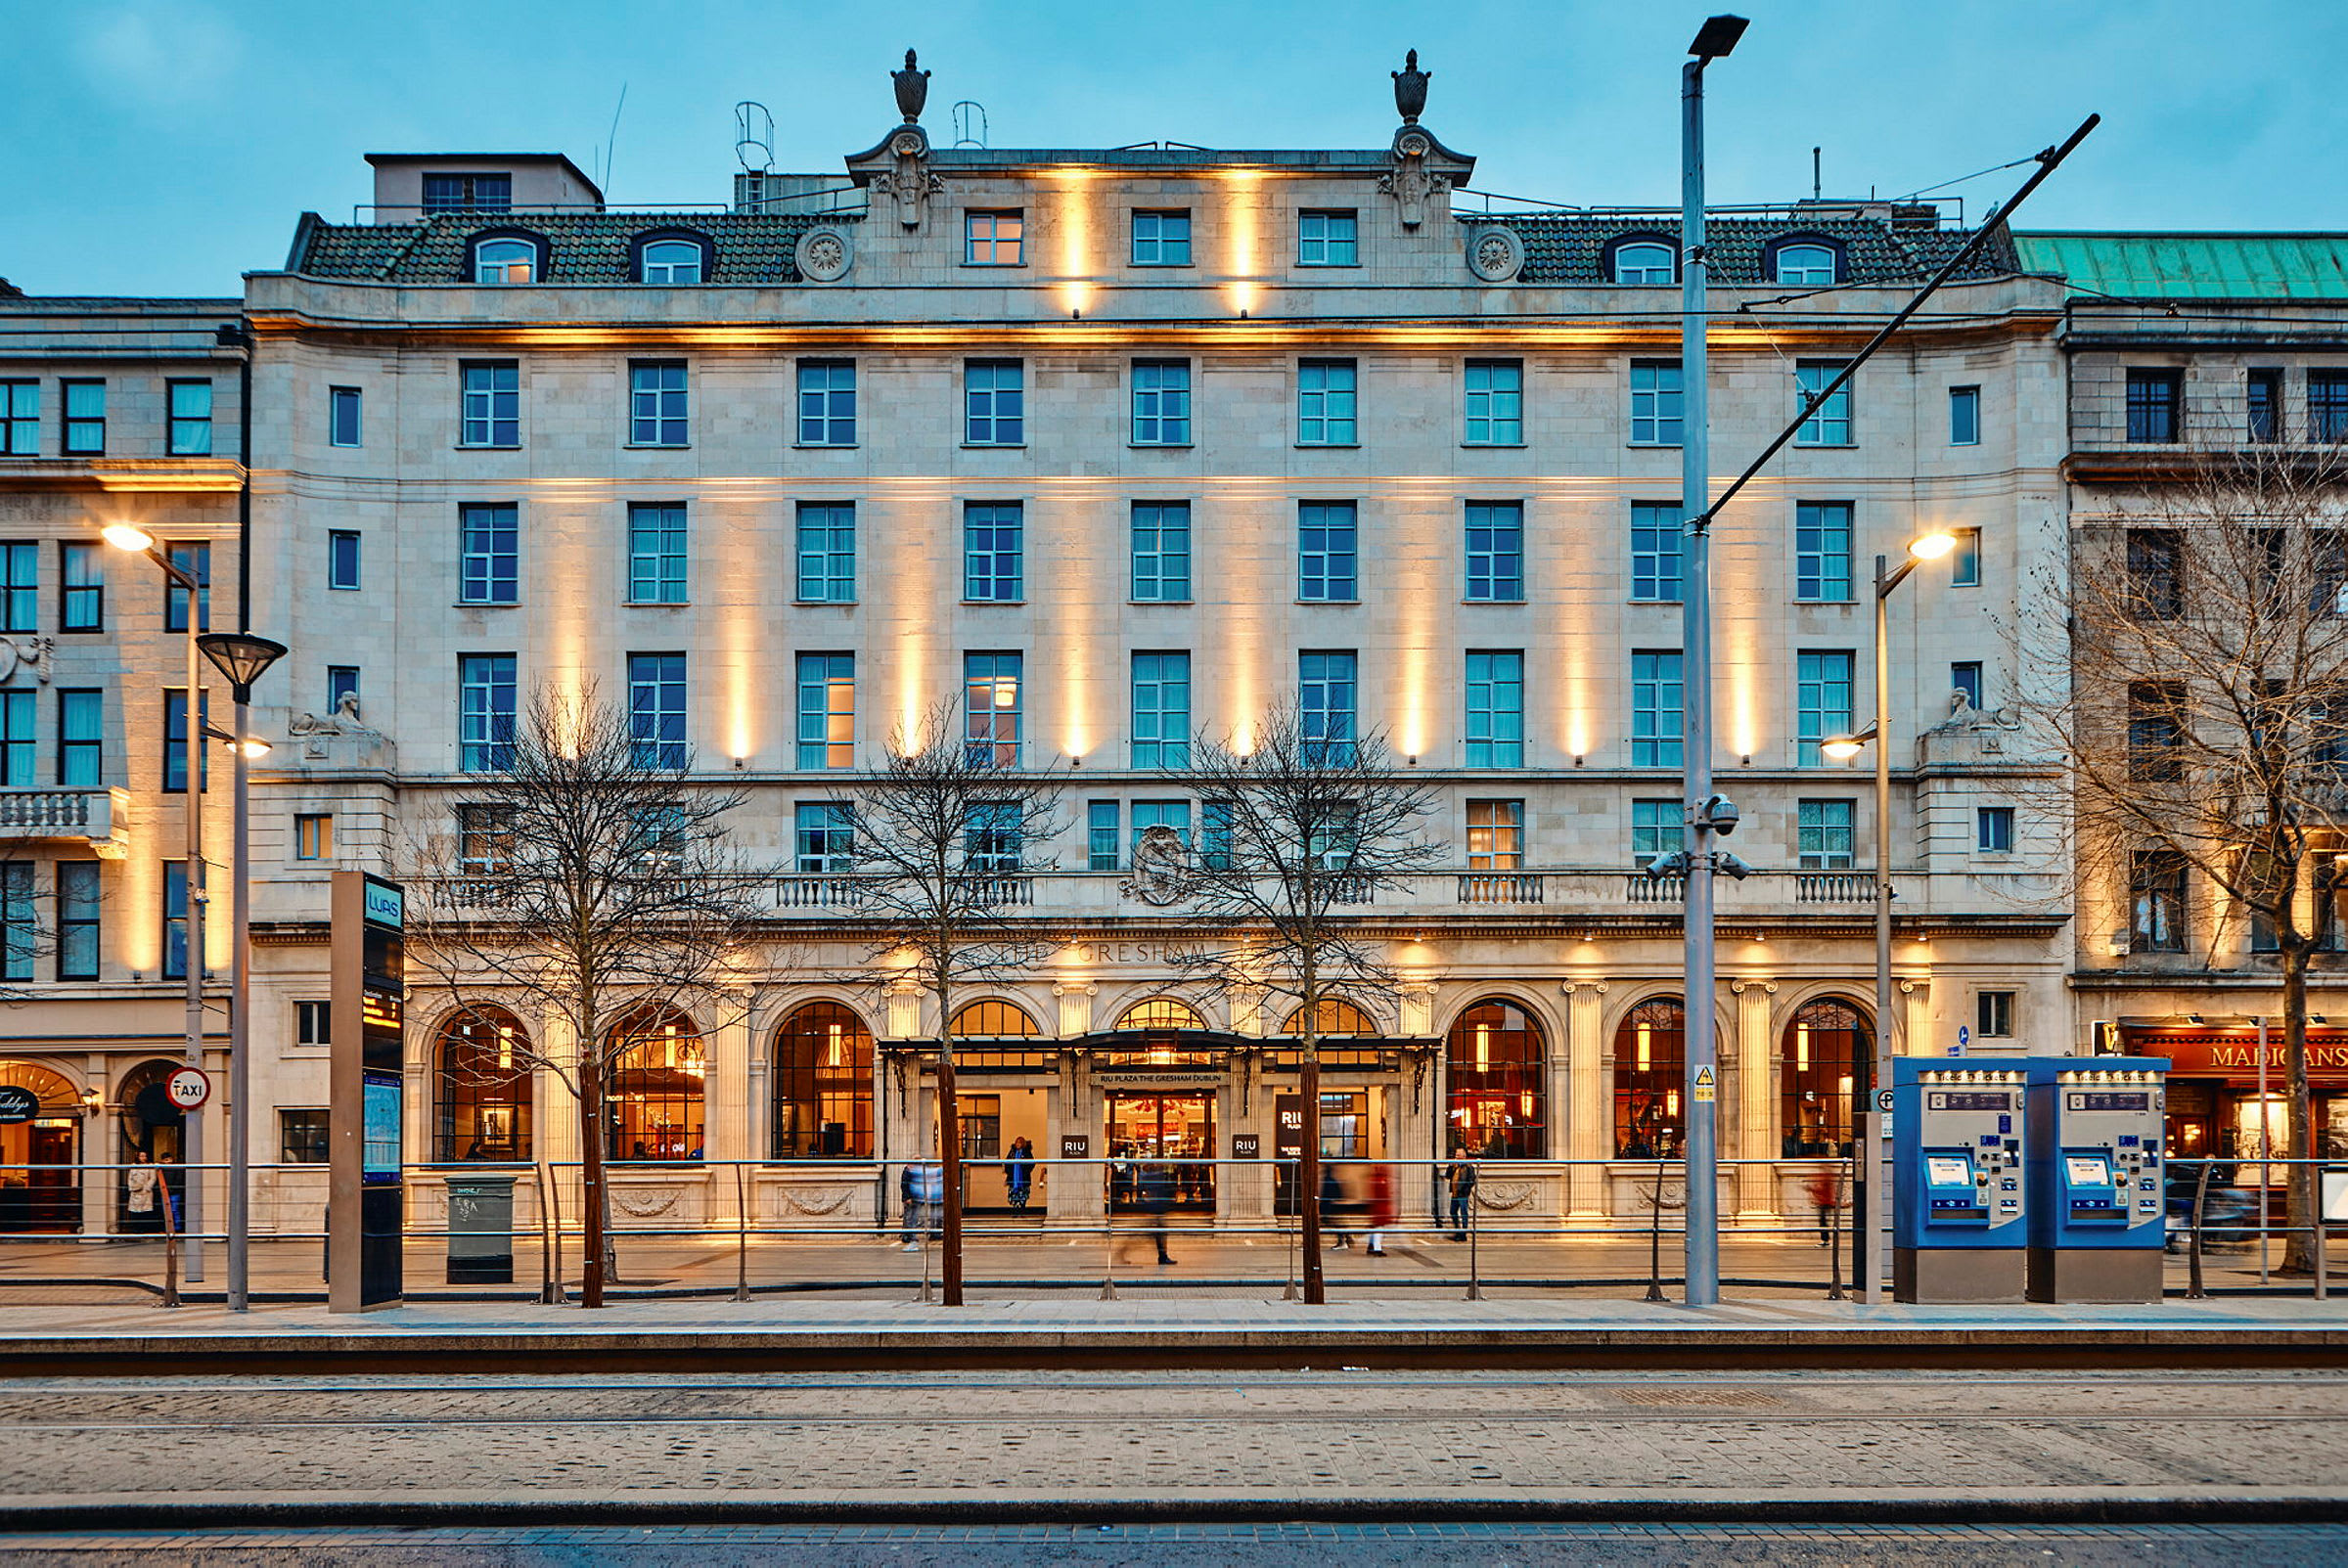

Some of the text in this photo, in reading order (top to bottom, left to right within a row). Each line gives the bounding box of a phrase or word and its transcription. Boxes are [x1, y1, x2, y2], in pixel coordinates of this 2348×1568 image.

[369, 891, 399, 918] LUAS
[1078, 942, 1207, 963] GRESHAM
[173, 1085, 202, 1097] TAXI
[1064, 1142, 1085, 1151] RIU
[1236, 1141, 1256, 1150] RIU
